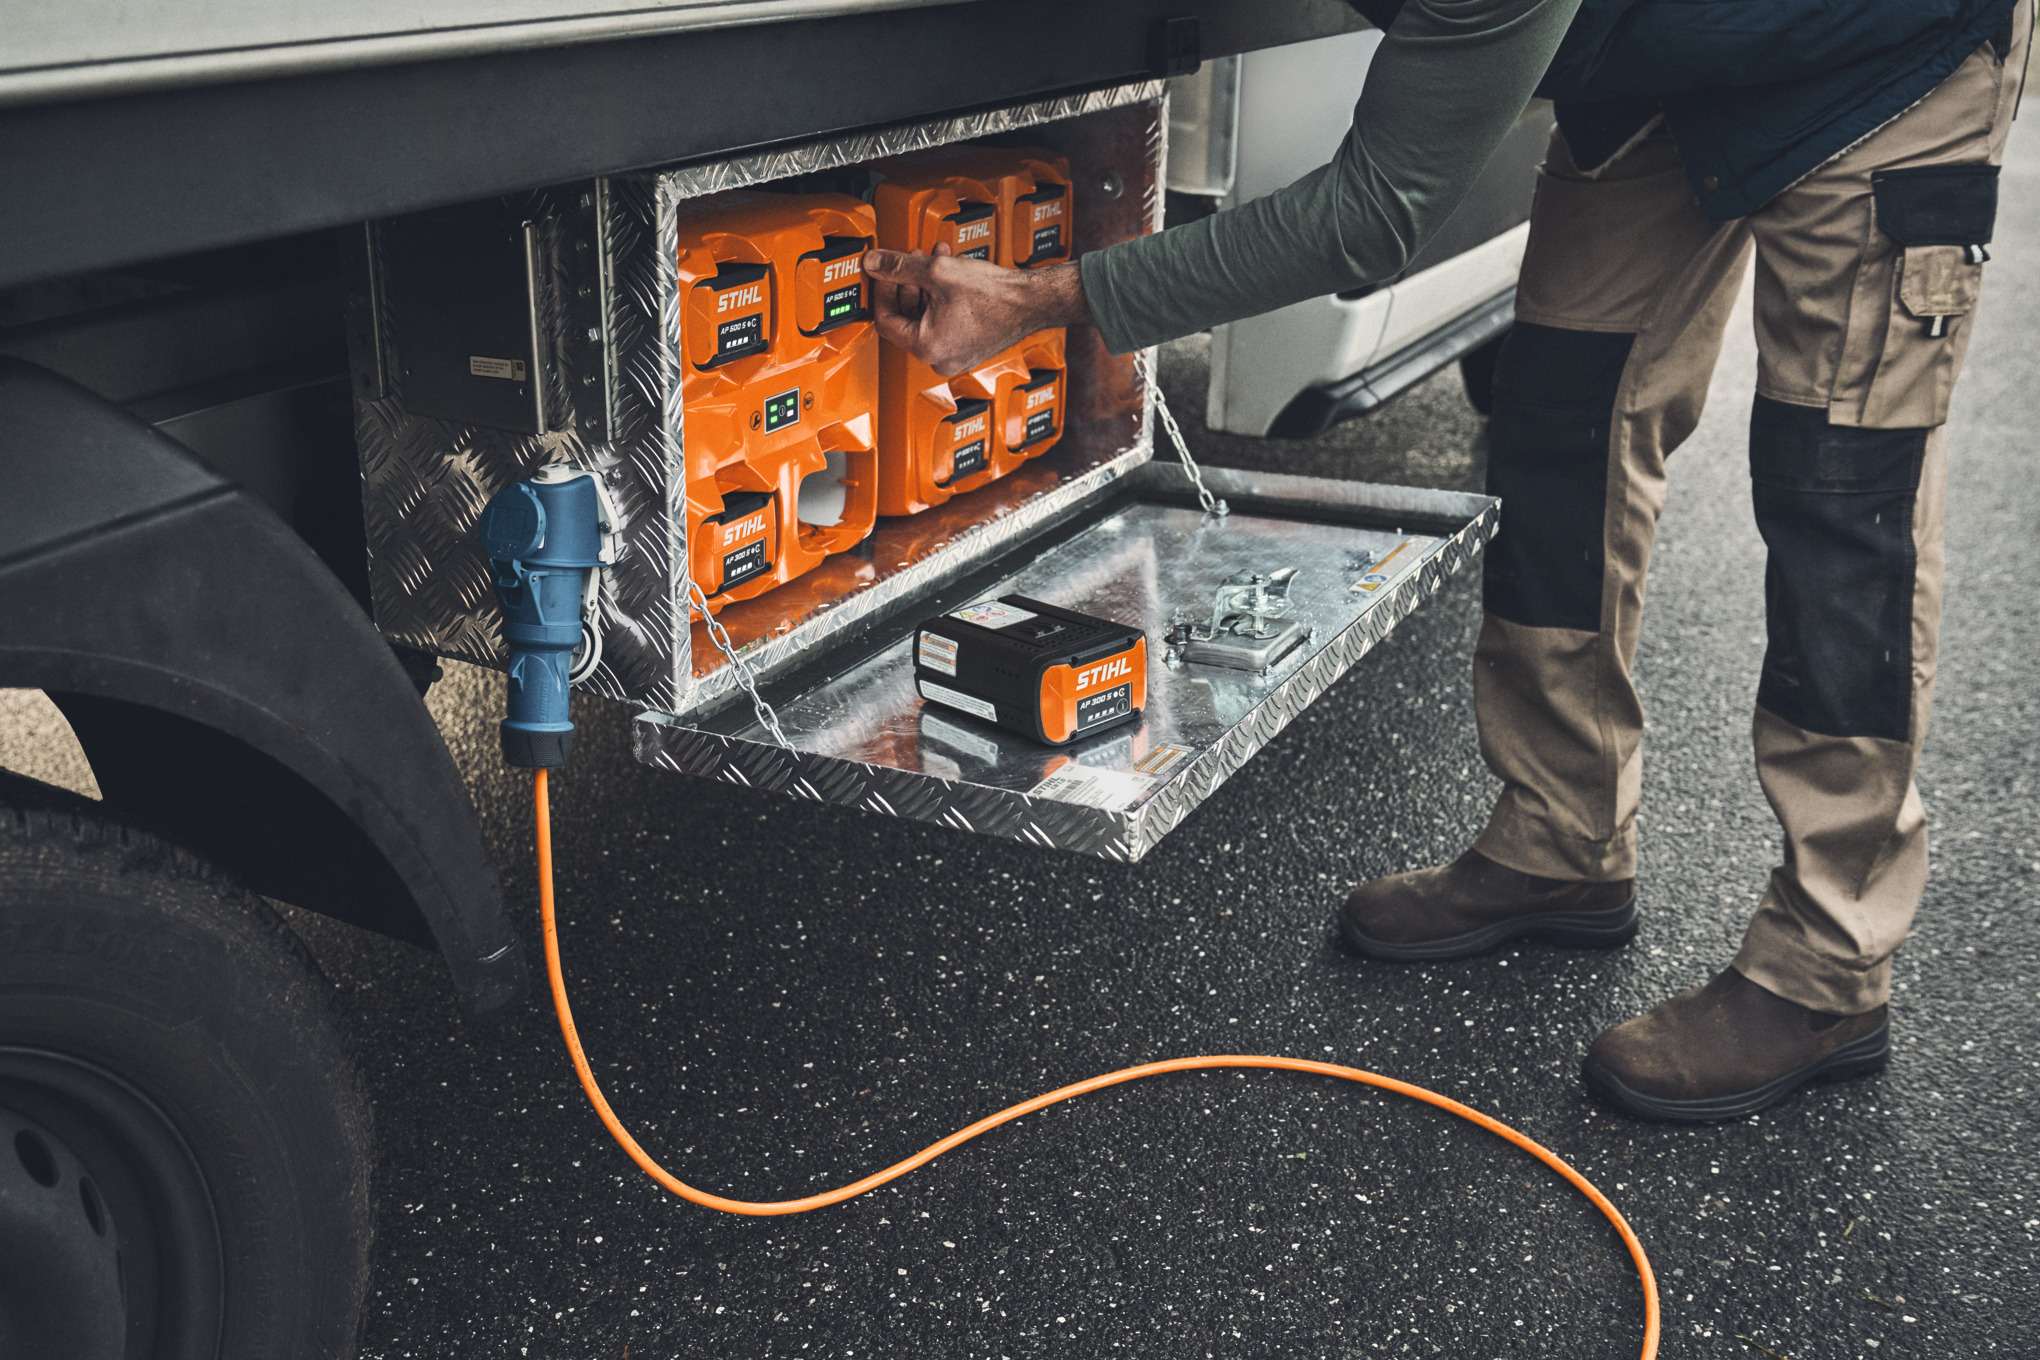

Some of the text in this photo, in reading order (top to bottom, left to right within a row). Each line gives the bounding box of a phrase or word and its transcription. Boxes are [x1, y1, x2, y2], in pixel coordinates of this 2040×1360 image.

[1033, 201, 1062, 222] STIHL
[957, 221, 991, 244] STIHL
[823, 257, 862, 283] STIHL
[717, 285, 762, 313] STIHL
[720, 326, 729, 335] AP
[1026, 386, 1056, 409] STIHL
[953, 416, 986, 442] STIHL
[723, 514, 767, 547] STIHL
[1076, 657, 1132, 691] STIHL
[1079, 700, 1091, 710] AP
[1091, 694, 1106, 706] 300
[1032, 776, 1061, 796] STIHL
